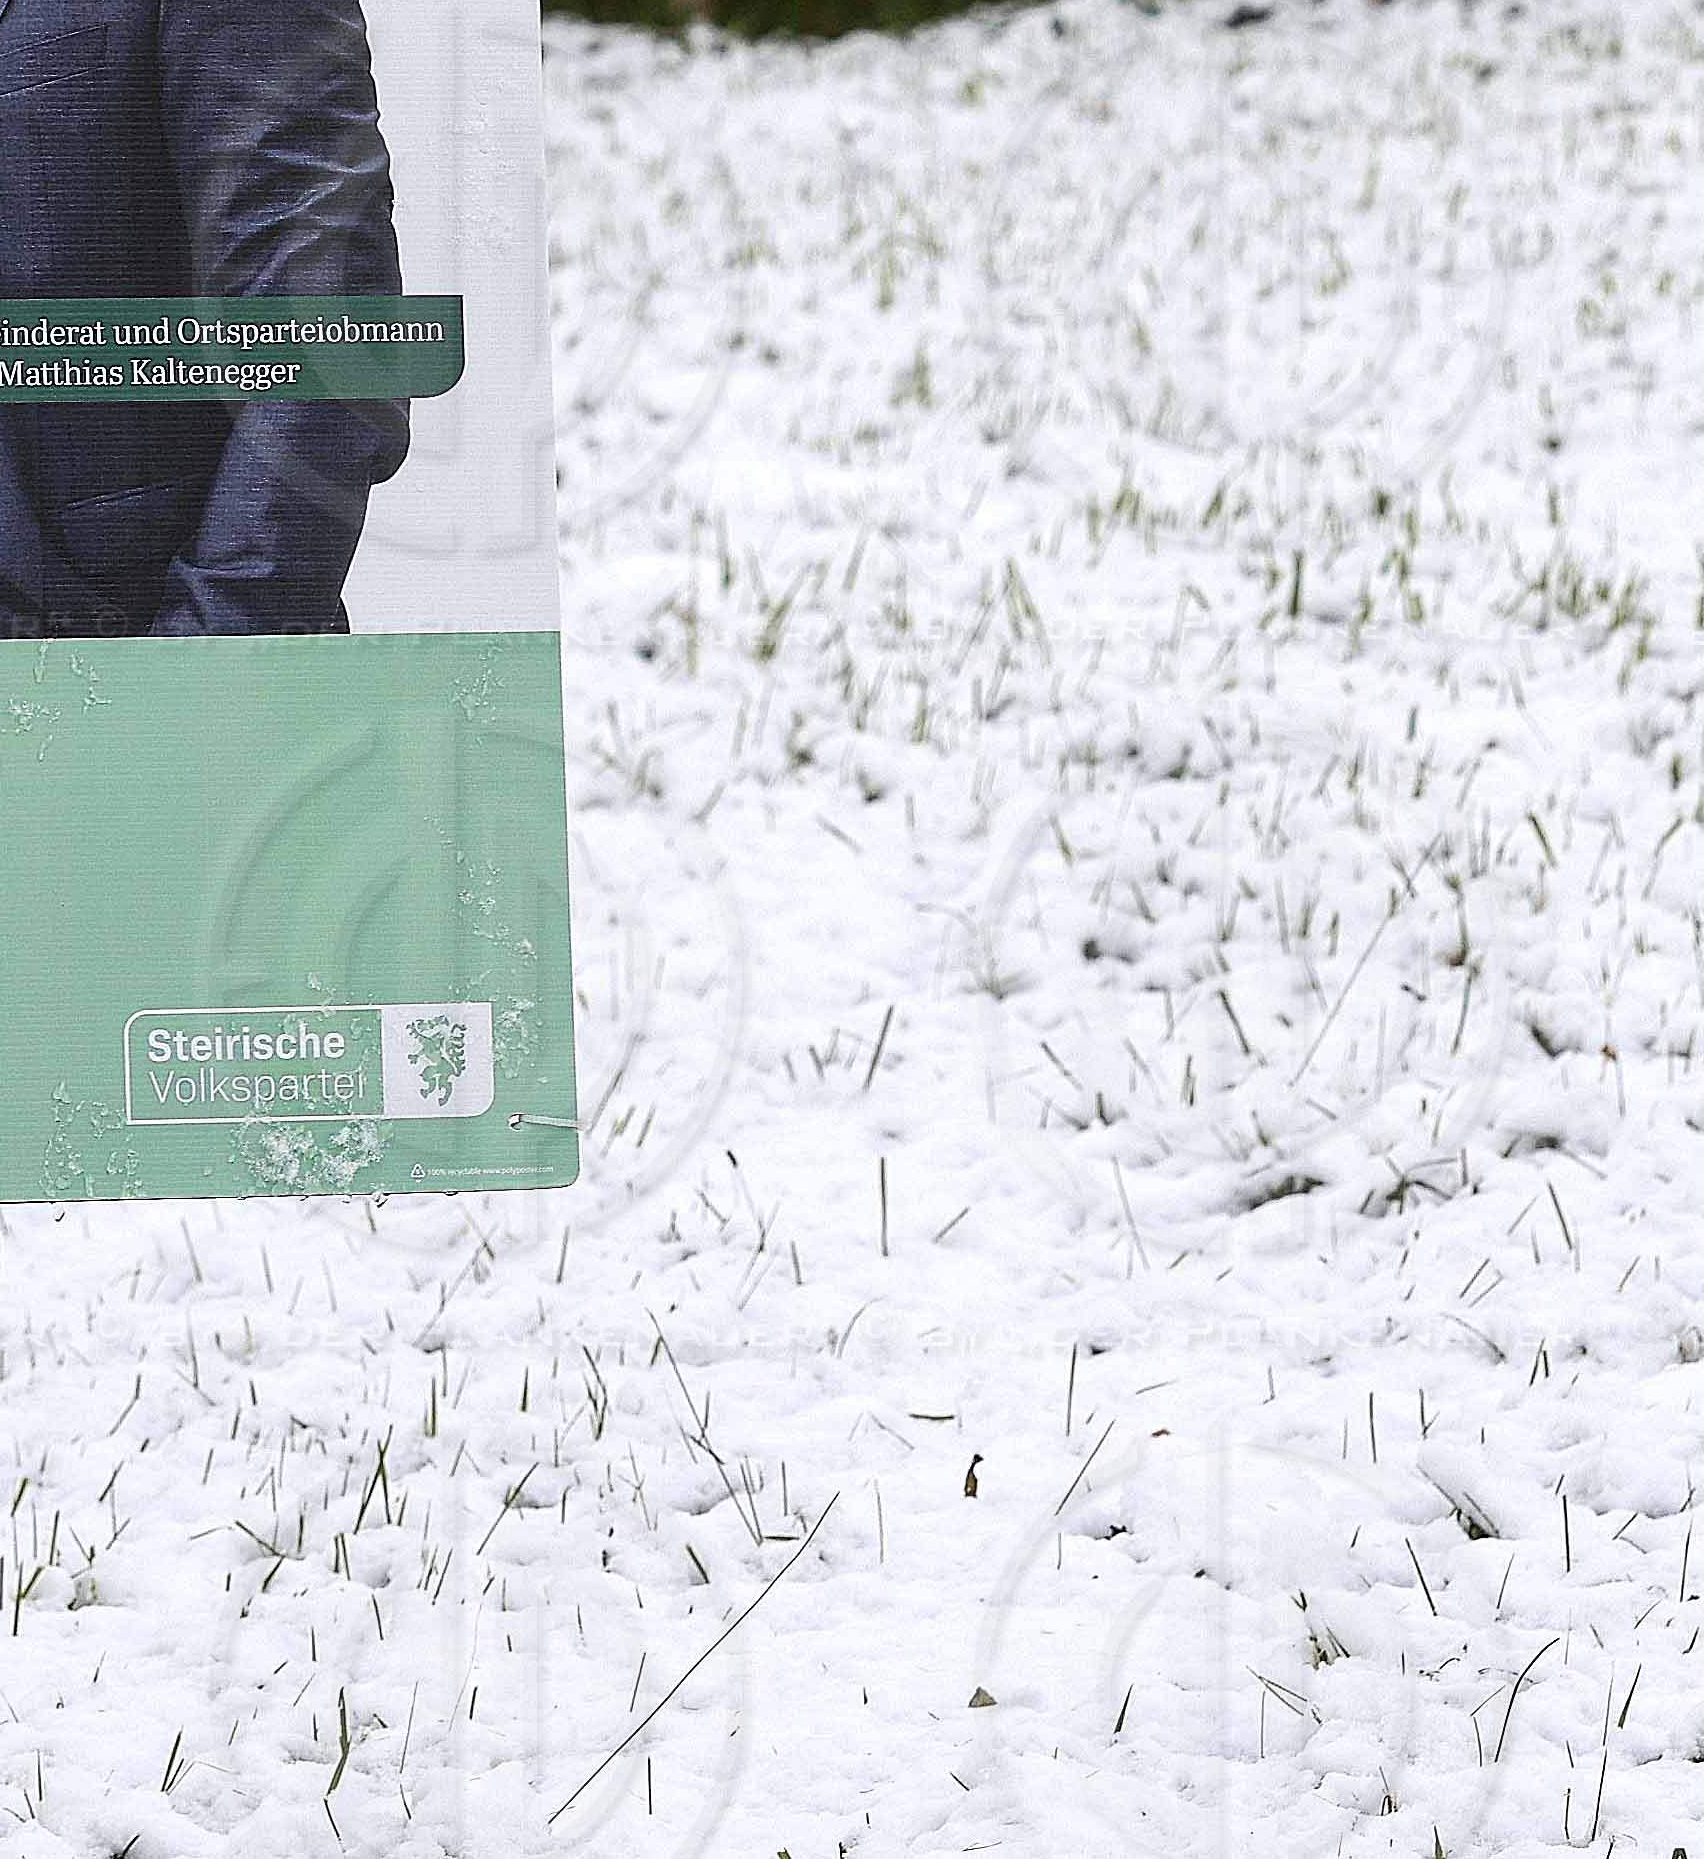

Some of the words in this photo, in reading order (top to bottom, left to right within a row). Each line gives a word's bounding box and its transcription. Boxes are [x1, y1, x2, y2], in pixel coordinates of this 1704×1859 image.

[112, 317, 172, 345] und
[176, 316, 445, 353] Ortsparteiobmann
[130, 357, 302, 391] Kaltenegger
[147, 1026, 346, 1064] Steirische
[148, 1065, 368, 1106] Volkspartei
